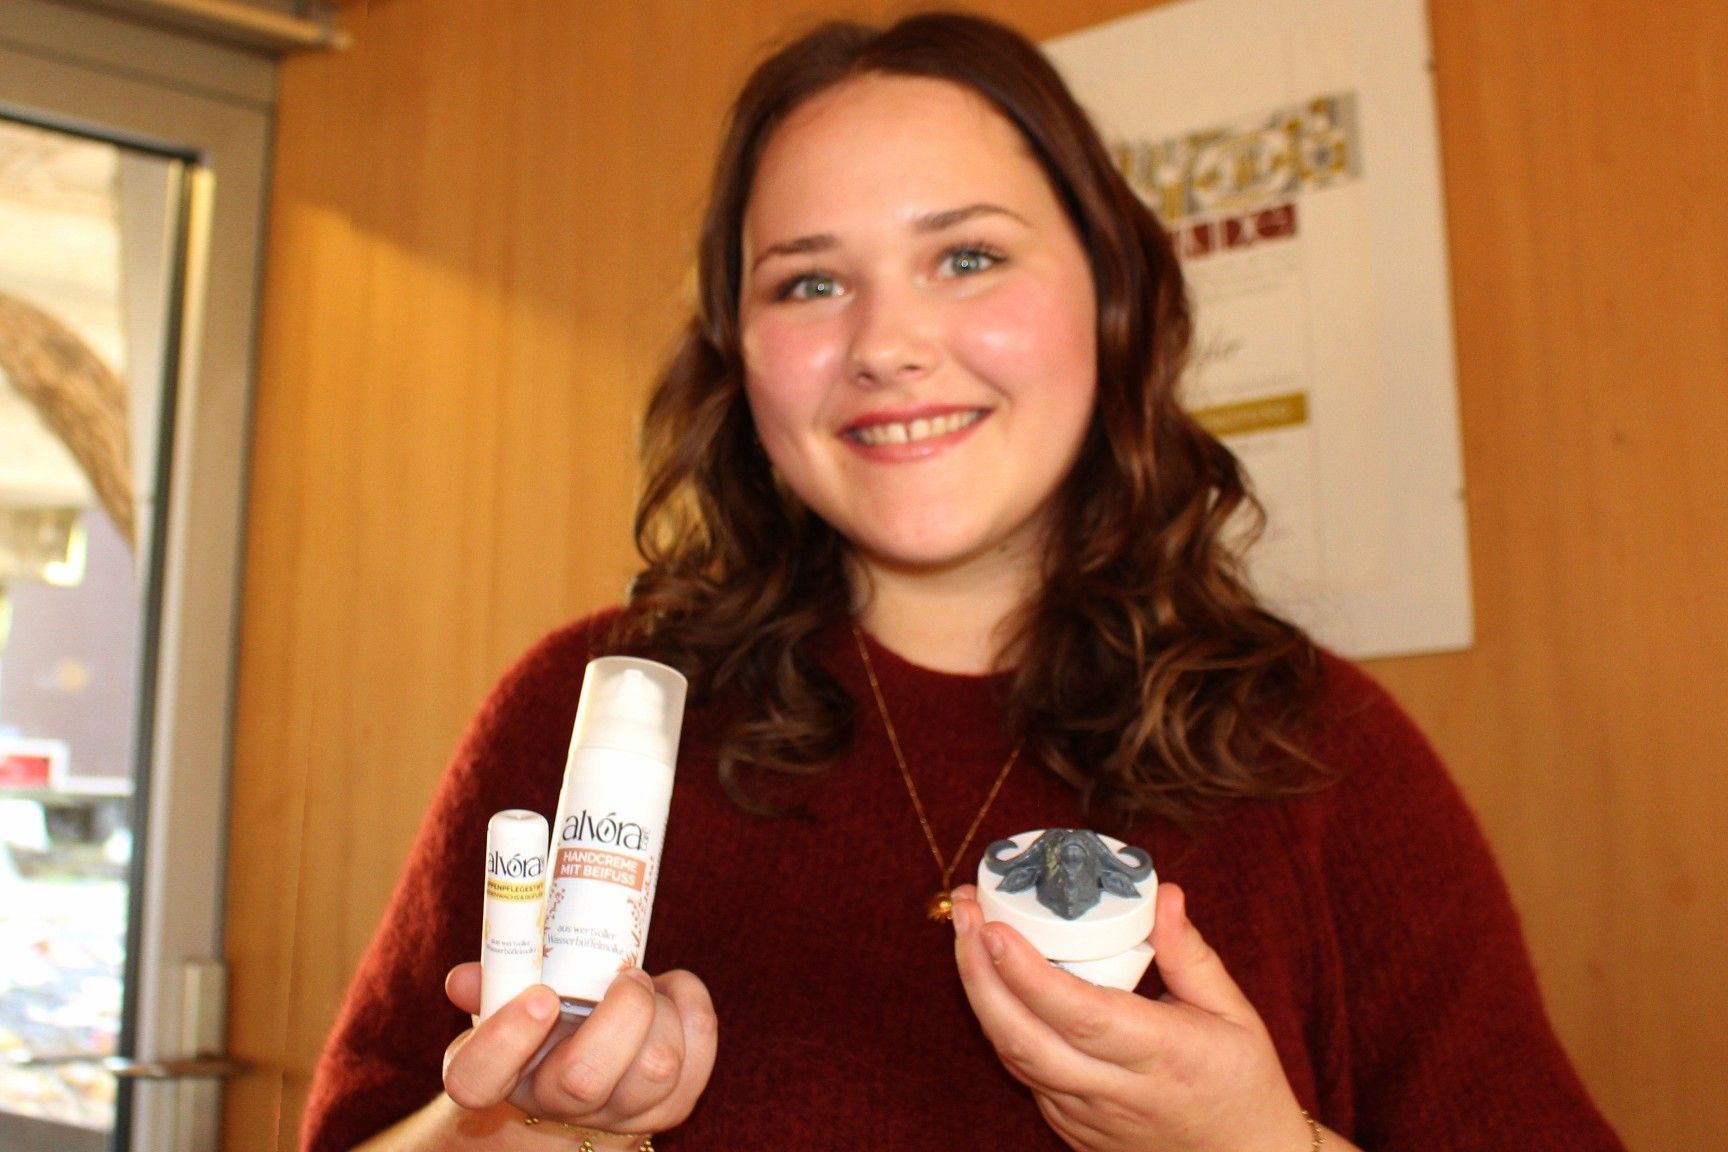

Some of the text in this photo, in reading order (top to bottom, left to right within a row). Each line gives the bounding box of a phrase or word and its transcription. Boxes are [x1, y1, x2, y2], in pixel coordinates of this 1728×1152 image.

[563, 809, 642, 851] alvóra
[563, 850, 637, 871] HANDCREME
[560, 864, 636, 885] MIT BEIFUSS
[557, 925, 571, 933] aus
